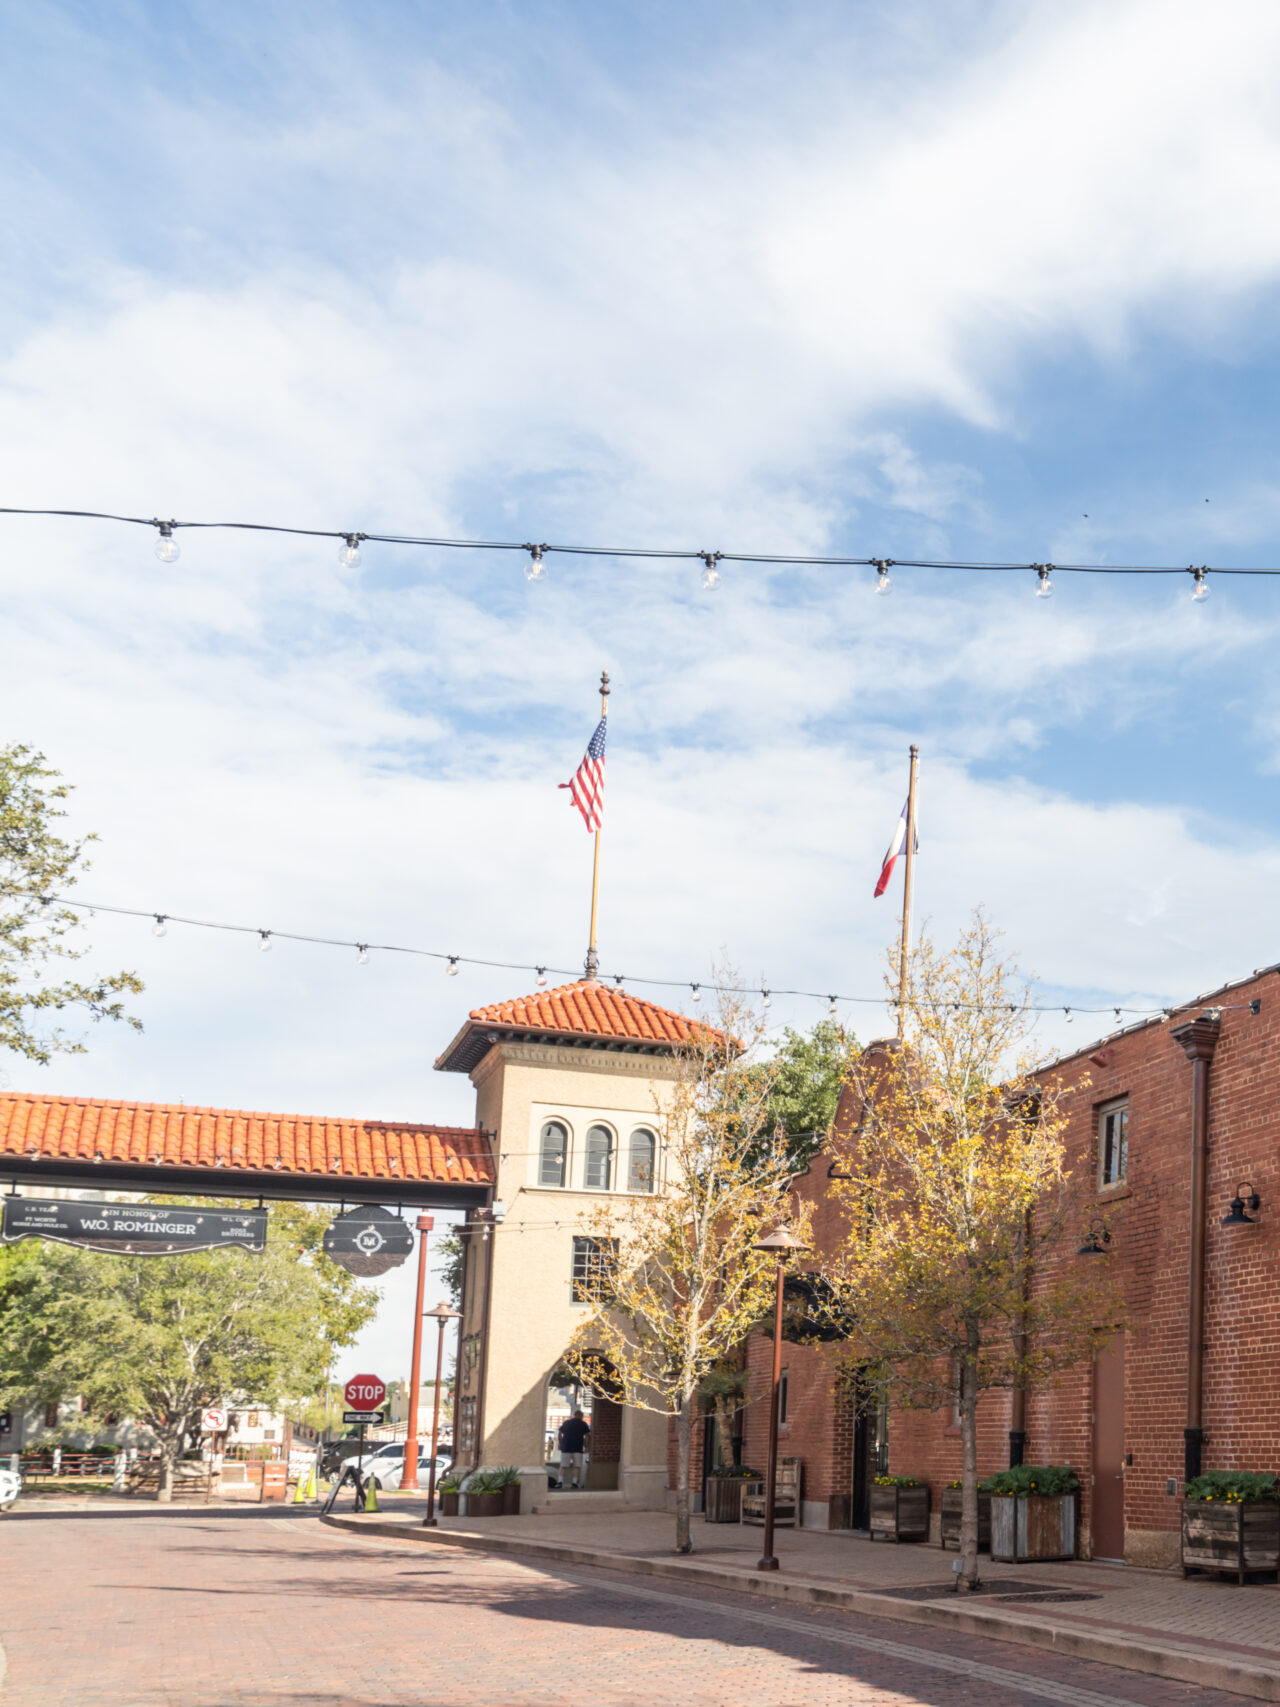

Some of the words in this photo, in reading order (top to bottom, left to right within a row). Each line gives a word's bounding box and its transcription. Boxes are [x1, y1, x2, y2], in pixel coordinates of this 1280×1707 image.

[157, 1211, 170, 1219] OF
[114, 1221, 196, 1235] ROMINGER
[347, 1385, 384, 1400] STOP
